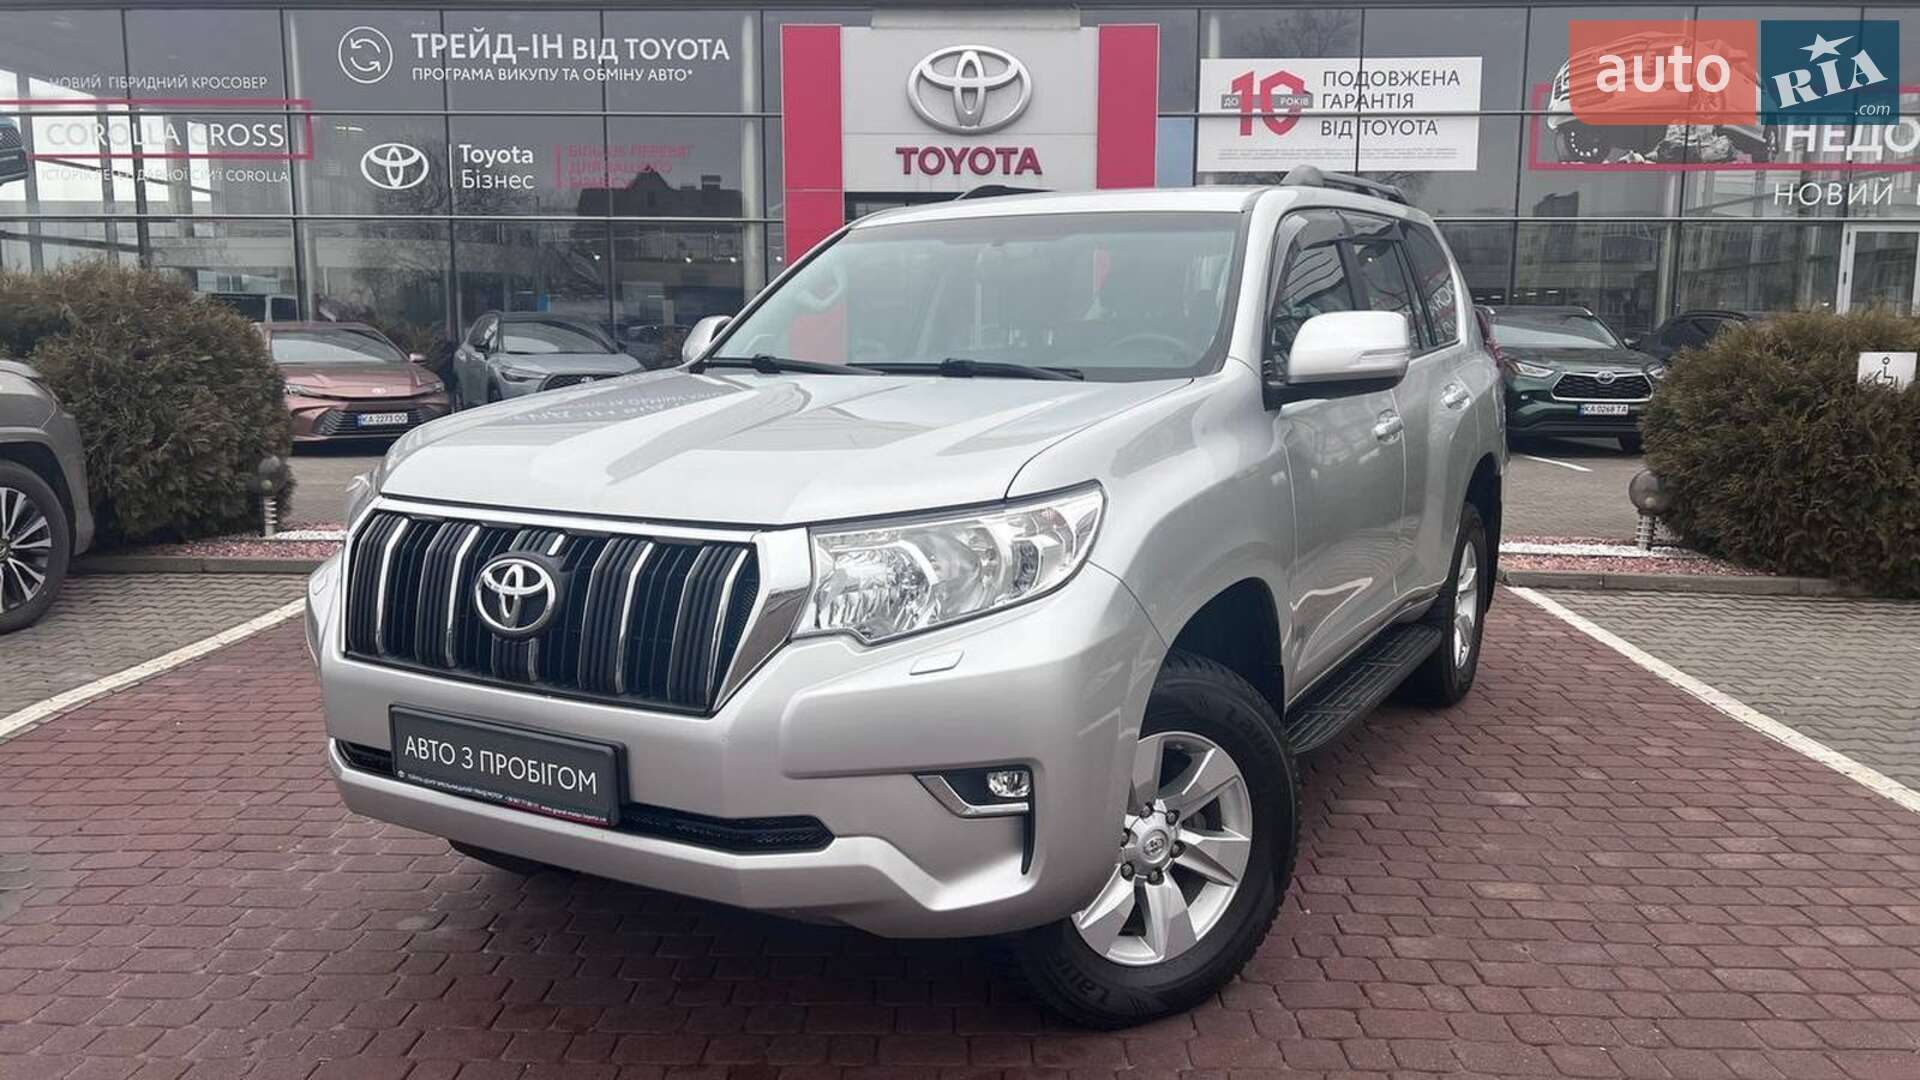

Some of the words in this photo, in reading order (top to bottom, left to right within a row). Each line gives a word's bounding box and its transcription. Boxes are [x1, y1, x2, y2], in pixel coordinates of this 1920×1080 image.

[411, 27, 563, 64] ТРЕЙД-ІН
[572, 38, 619, 64] ВІД
[624, 38, 731, 61] TOYOTA
[108, 74, 188, 89] ГІБРИДНИЙ
[192, 77, 268, 90] КРОСОВЕР
[412, 67, 494, 82] ПРОГРАМА
[498, 67, 559, 82] ВИКУПУ
[562, 67, 581, 81] ТА
[583, 67, 644, 82] ОБМІНУ
[1323, 69, 1461, 90] ПОДОВЖЕНА
[1223, 98, 1239, 108] ДО
[1231, 70, 1306, 137] 10
[1322, 93, 1414, 109] ГАРАНТІЯ
[47, 123, 181, 146] COROLLA
[190, 123, 284, 147] CROSS
[1321, 120, 1352, 138] ВІД
[1363, 119, 1438, 136] TOYOTA
[459, 144, 534, 175] Toyota
[895, 147, 1042, 176] TOYOTA
[226, 171, 288, 183] COROLLA
[461, 168, 534, 191] Бізнес
[1774, 178, 1893, 205] НОВИЙ
[405, 735, 456, 765] АВТО
[461, 747, 474, 769] З
[479, 750, 597, 795] ПРОБІГОМ
